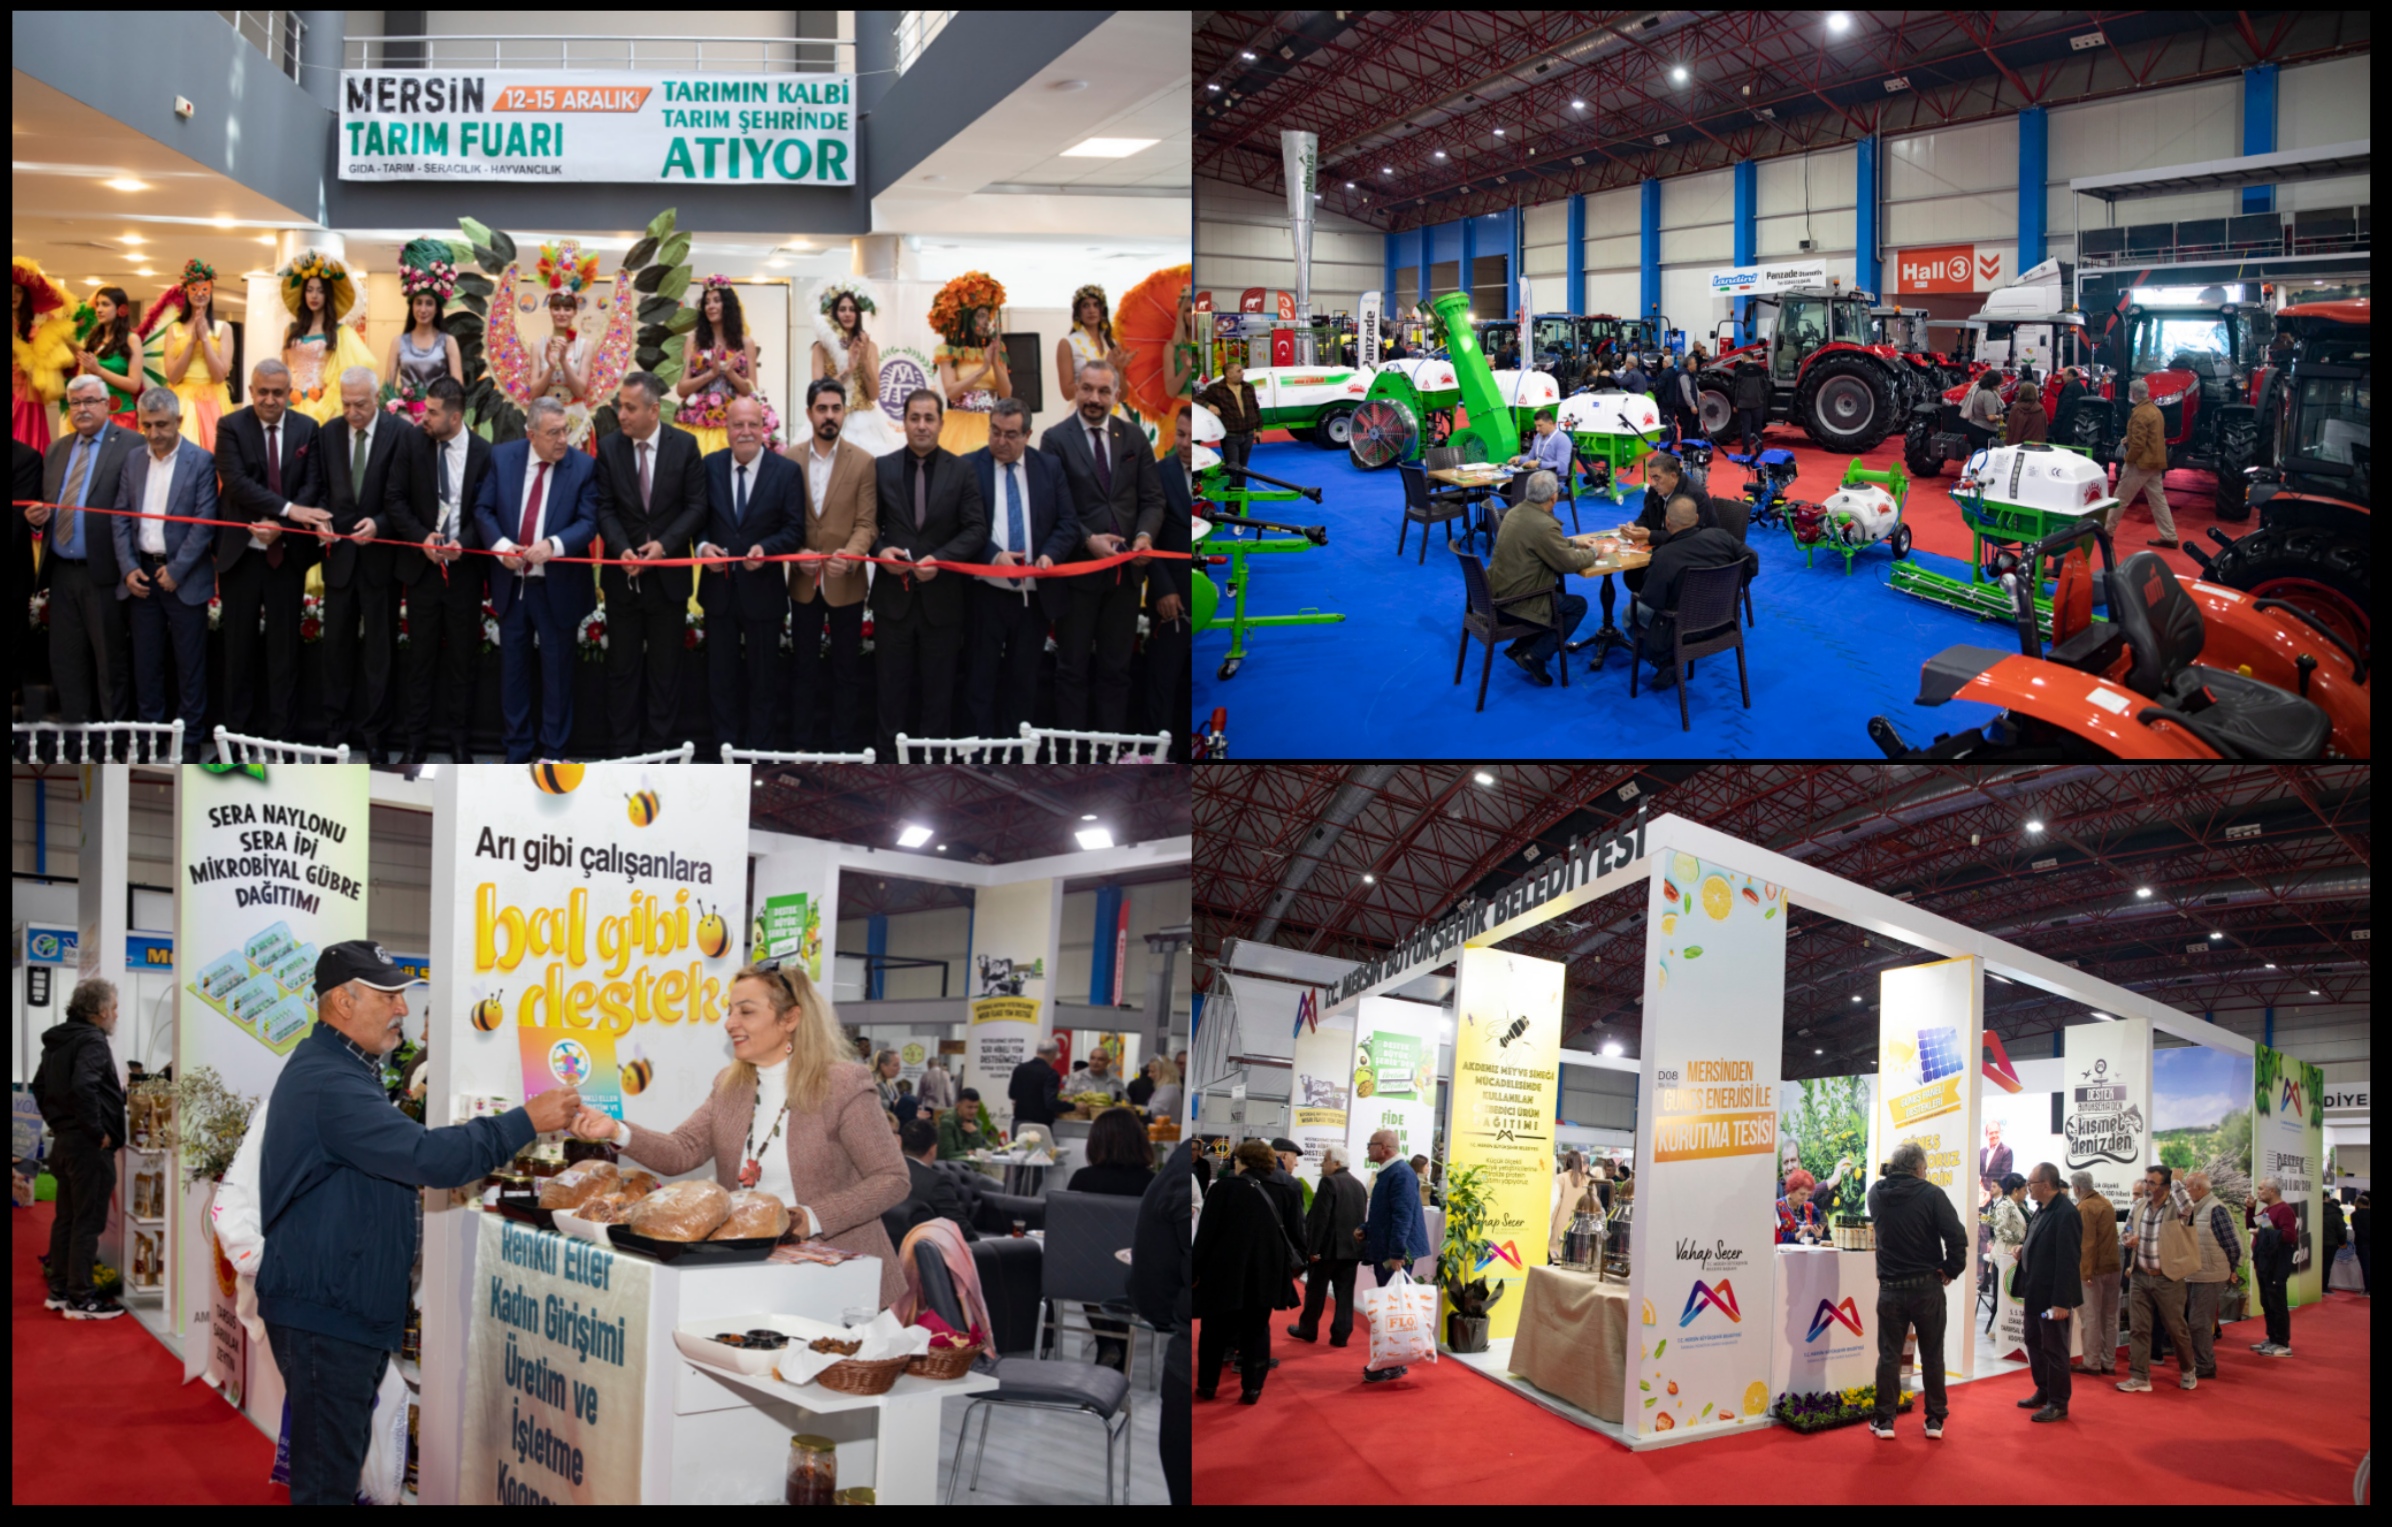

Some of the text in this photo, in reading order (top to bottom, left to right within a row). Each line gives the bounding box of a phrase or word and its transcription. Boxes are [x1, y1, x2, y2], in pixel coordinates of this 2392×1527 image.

[506, 90, 555, 110] 12-15
[561, 90, 636, 110] ARALIK
[662, 81, 768, 103] TARIMIN
[778, 79, 849, 105] KALBİ
[661, 107, 848, 135] TARIM ŞEHRİNDE
[346, 122, 563, 157] TARIM FUARI
[349, 163, 562, 175] GIDA TARIM SERACILIK HAYVANCILIK
[661, 137, 848, 181] ATIYOR
[1767, 269, 1797, 280] Panzade
[1903, 261, 1966, 281] Hall 3
[208, 803, 347, 844] SERA NAYLONU
[239, 830, 319, 860] SERA İPİ
[475, 826, 713, 884] Arı gibi çalışanlara
[189, 852, 362, 901] MİKROBİYAL GÜBRE
[235, 880, 320, 915] DAĞITIMI
[1341, 957, 1384, 1001] MERSİN
[1385, 896, 1488, 979] BÜYÜKŞEHİR
[1493, 794, 1649, 927] BELEDİYESİ
[475, 882, 691, 978] bal gibi
[1462, 1061, 1499, 1074] AKDENİZ
[1500, 1066, 1528, 1077] MEYVE
[1658, 1070, 1679, 1080] D08
[1687, 1057, 1753, 1082] MERSİNDEN
[1475, 1076, 1542, 1092] MÜCADELESİNDE
[1483, 1091, 1534, 1104] KULLANILAN
[1706, 1084, 1754, 1109] ENERJİSİ
[1756, 1084, 1772, 1107] İLE
[2086, 1088, 2114, 1101] DESTEK
[1382, 1109, 1404, 1125] FİDE
[1657, 1114, 1774, 1153] KURUTMA TESİSİ
[2071, 1133, 2132, 1155] denizden
[502, 1220, 614, 1290] Renkli Eller
[1676, 1237, 1713, 1270] Vahap
[491, 1276, 625, 1367] Kadın Girişimi
[1389, 1317, 1415, 1328] FLO
[505, 1332, 598, 1425] Üretim ve
[512, 1397, 584, 1486] İşletme
